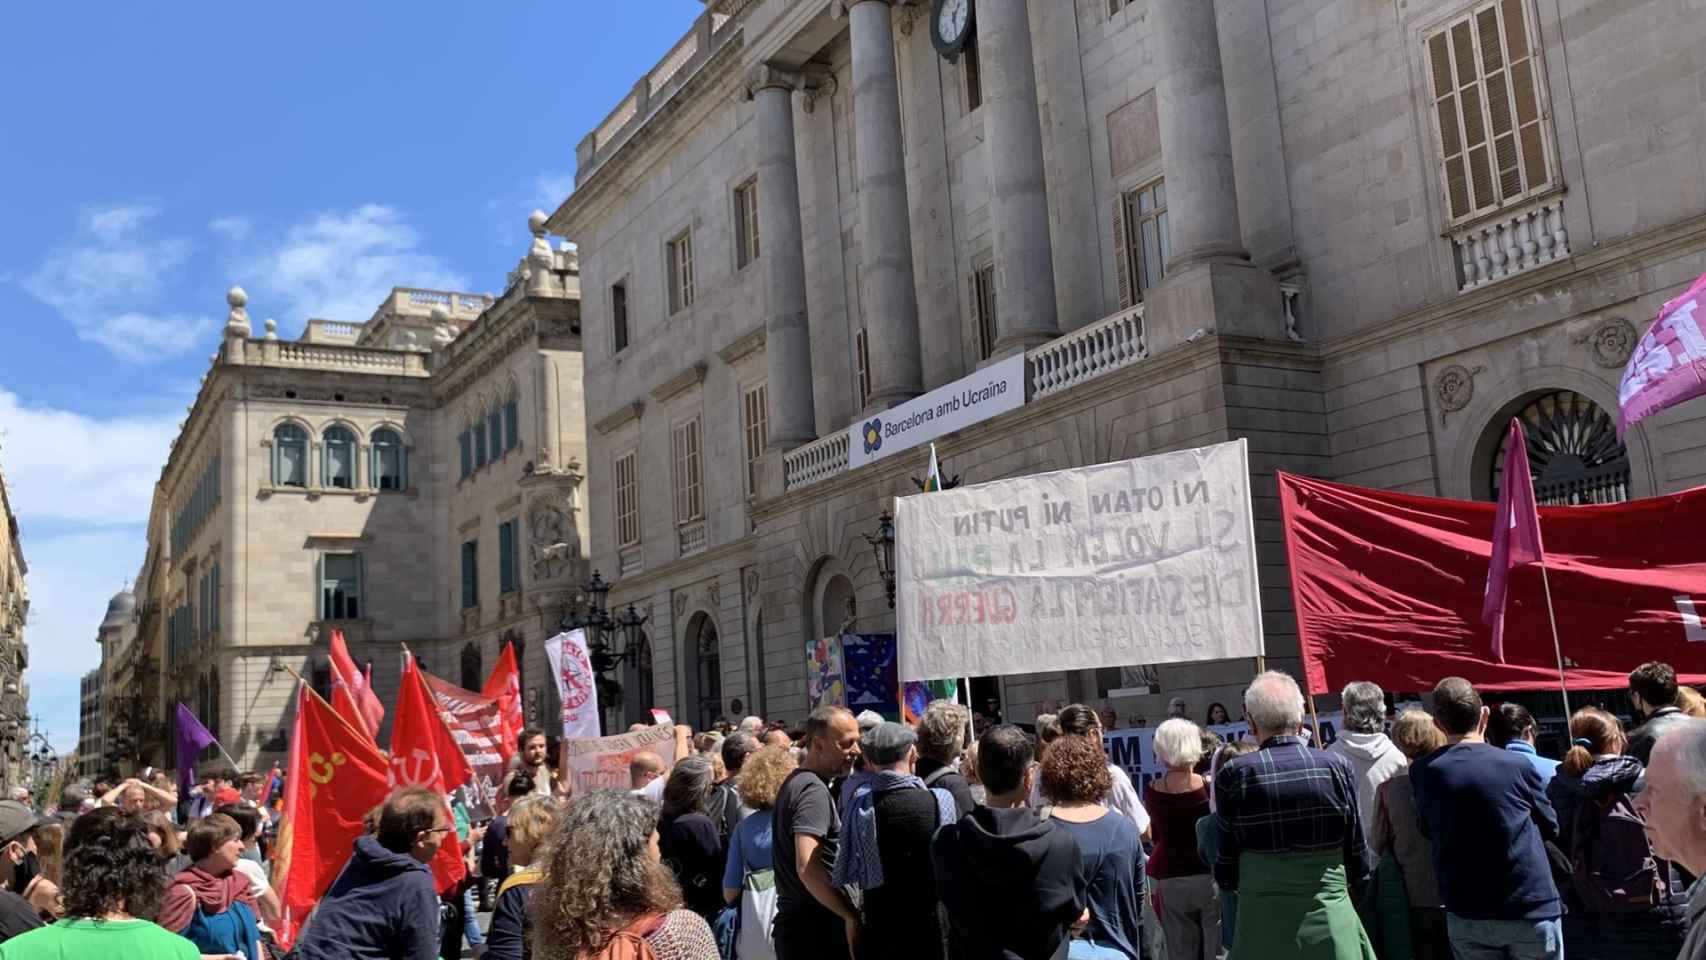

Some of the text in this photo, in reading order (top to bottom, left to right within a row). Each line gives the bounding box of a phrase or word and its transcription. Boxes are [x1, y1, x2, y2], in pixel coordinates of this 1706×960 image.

[884, 379, 1008, 438] Barcelona amb Ucraïna
